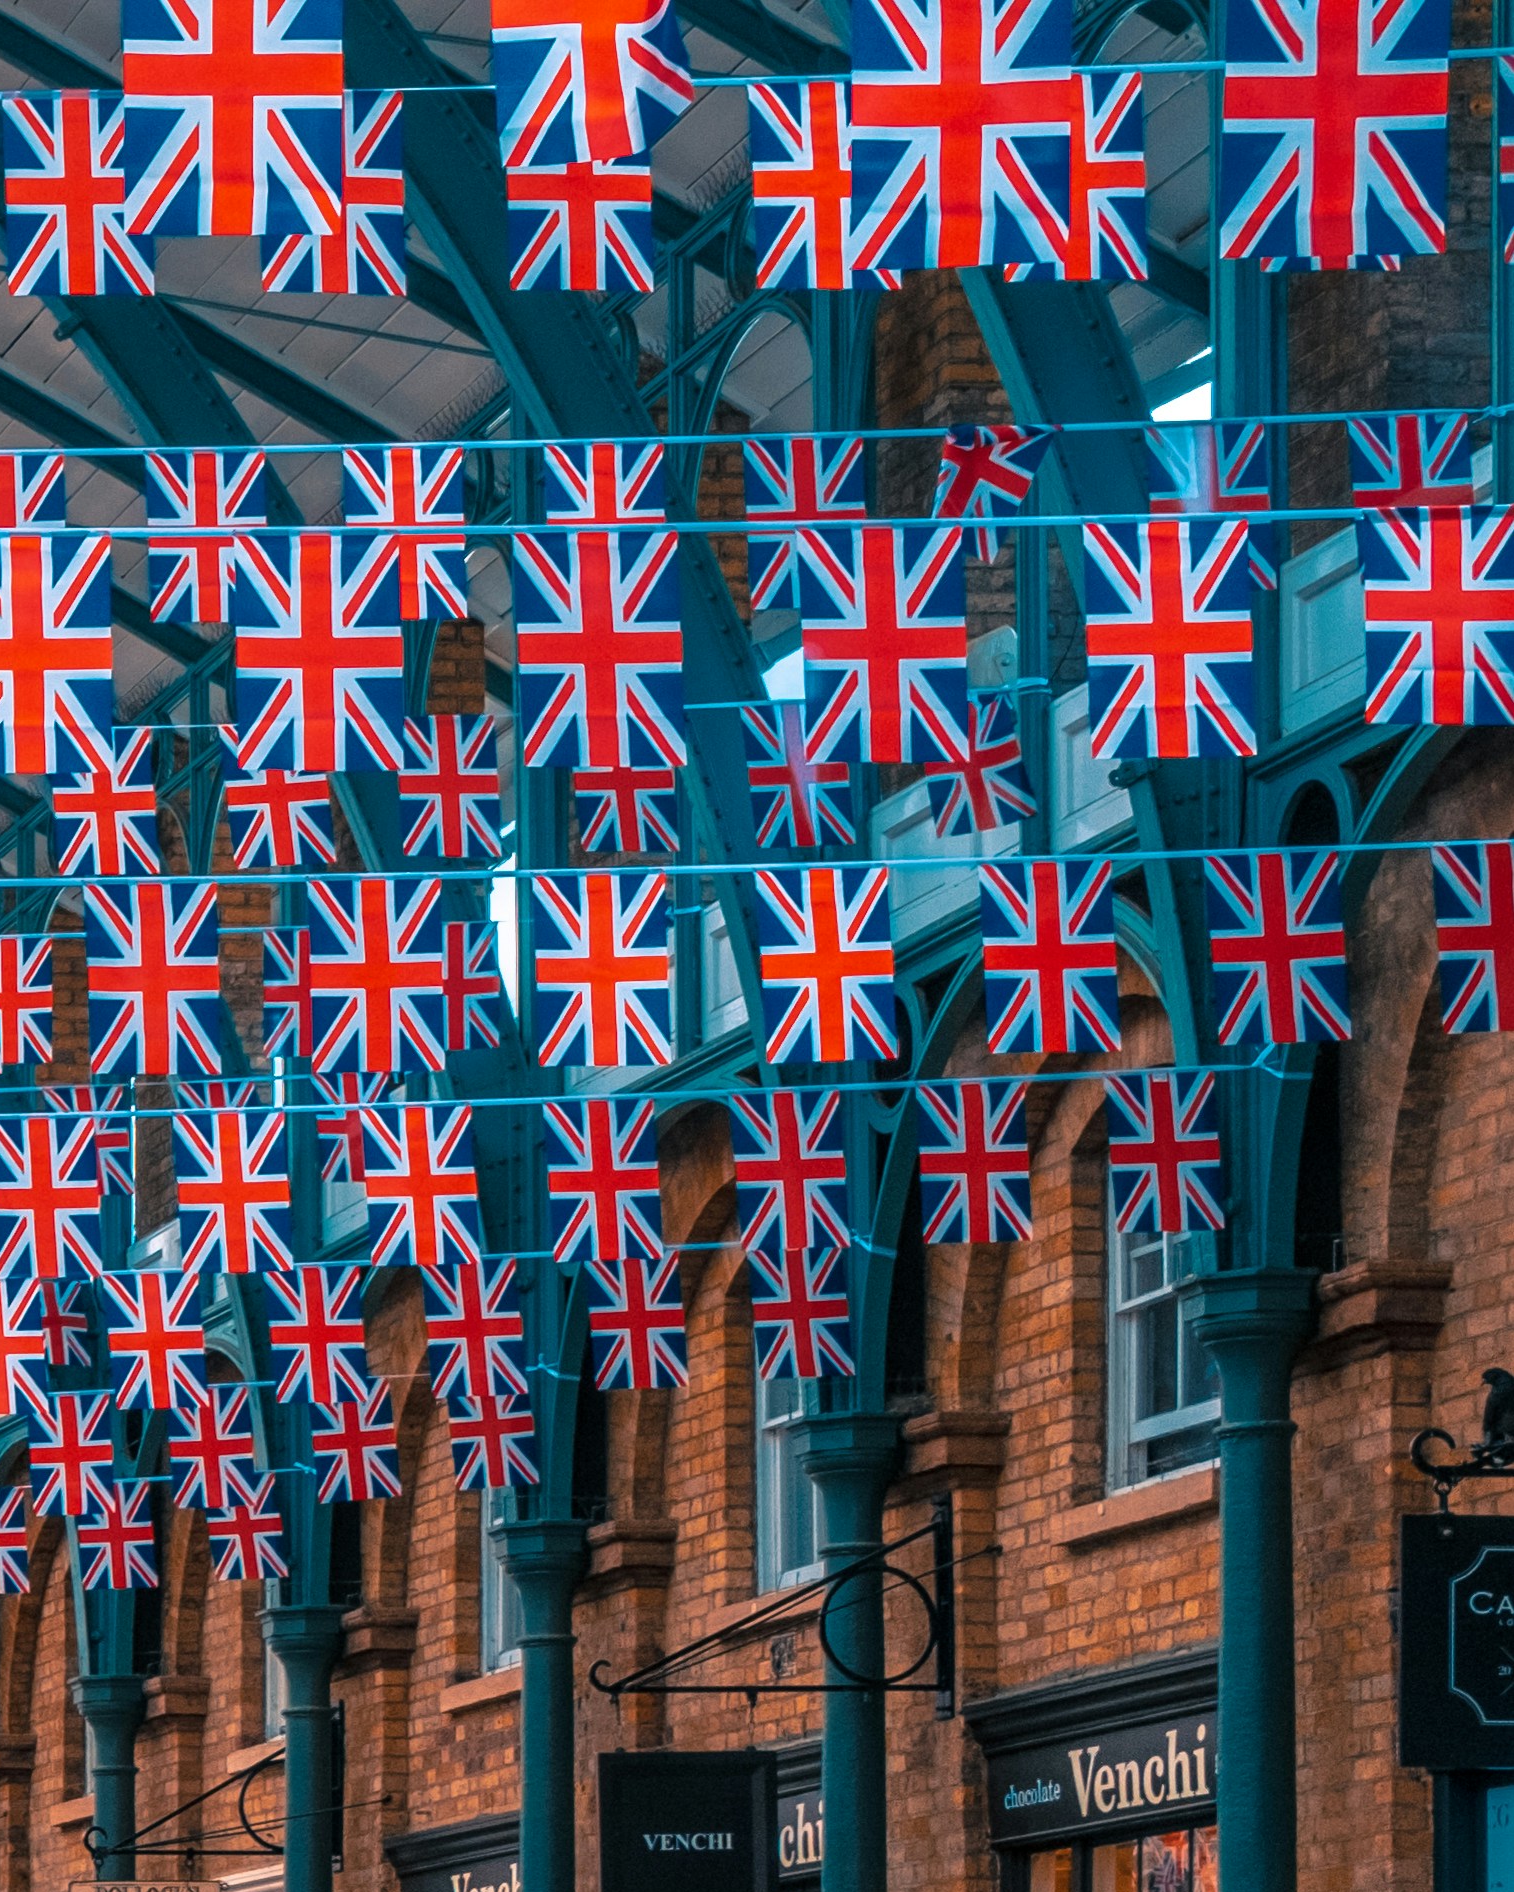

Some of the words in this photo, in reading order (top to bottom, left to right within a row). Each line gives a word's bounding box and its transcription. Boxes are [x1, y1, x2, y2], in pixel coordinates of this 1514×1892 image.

[1004, 1777, 1061, 1811] chocolate
[1068, 1723, 1210, 1818] Venchi
[642, 1832, 734, 1851] VENCHI
